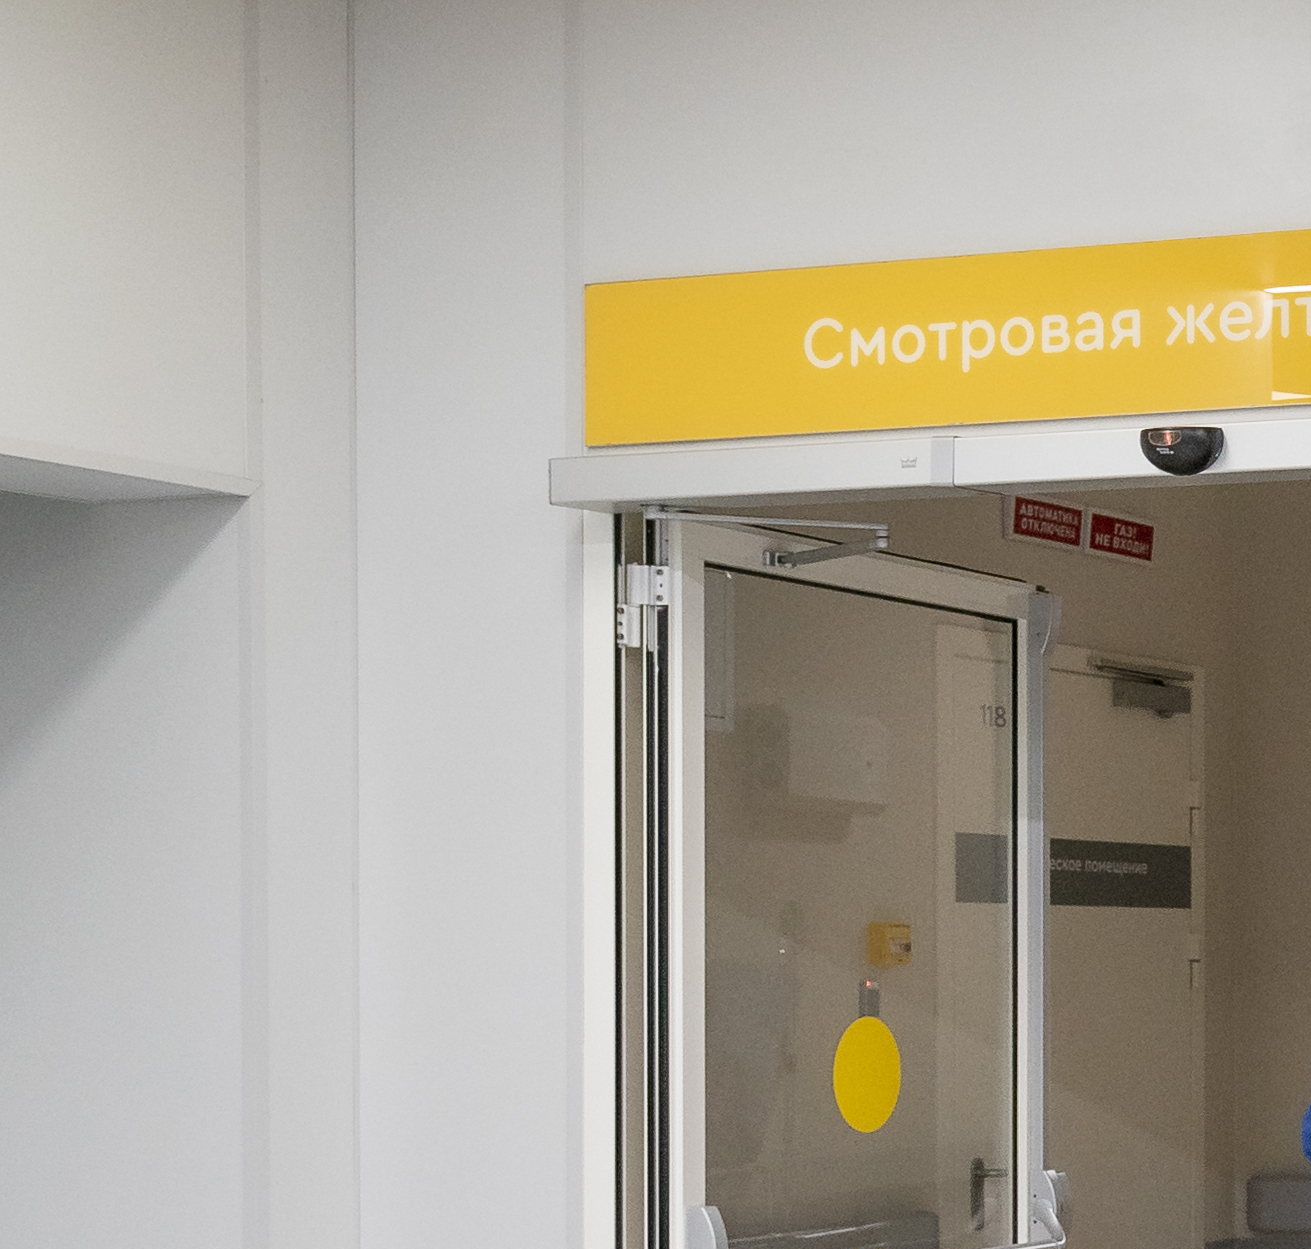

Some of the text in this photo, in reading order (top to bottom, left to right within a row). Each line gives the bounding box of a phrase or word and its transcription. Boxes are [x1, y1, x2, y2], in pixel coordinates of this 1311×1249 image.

[802, 307, 1142, 374] Смотровая
[1019, 502, 1079, 526] АВТОМАТИКА
[1020, 517, 1076, 540] ОТКЛЮЧЕНА
[1095, 532, 1111, 547] НЕ
[1113, 523, 1138, 540] ГАЗ!
[980, 703, 1007, 728] 118
[1084, 860, 1148, 877] помещение
